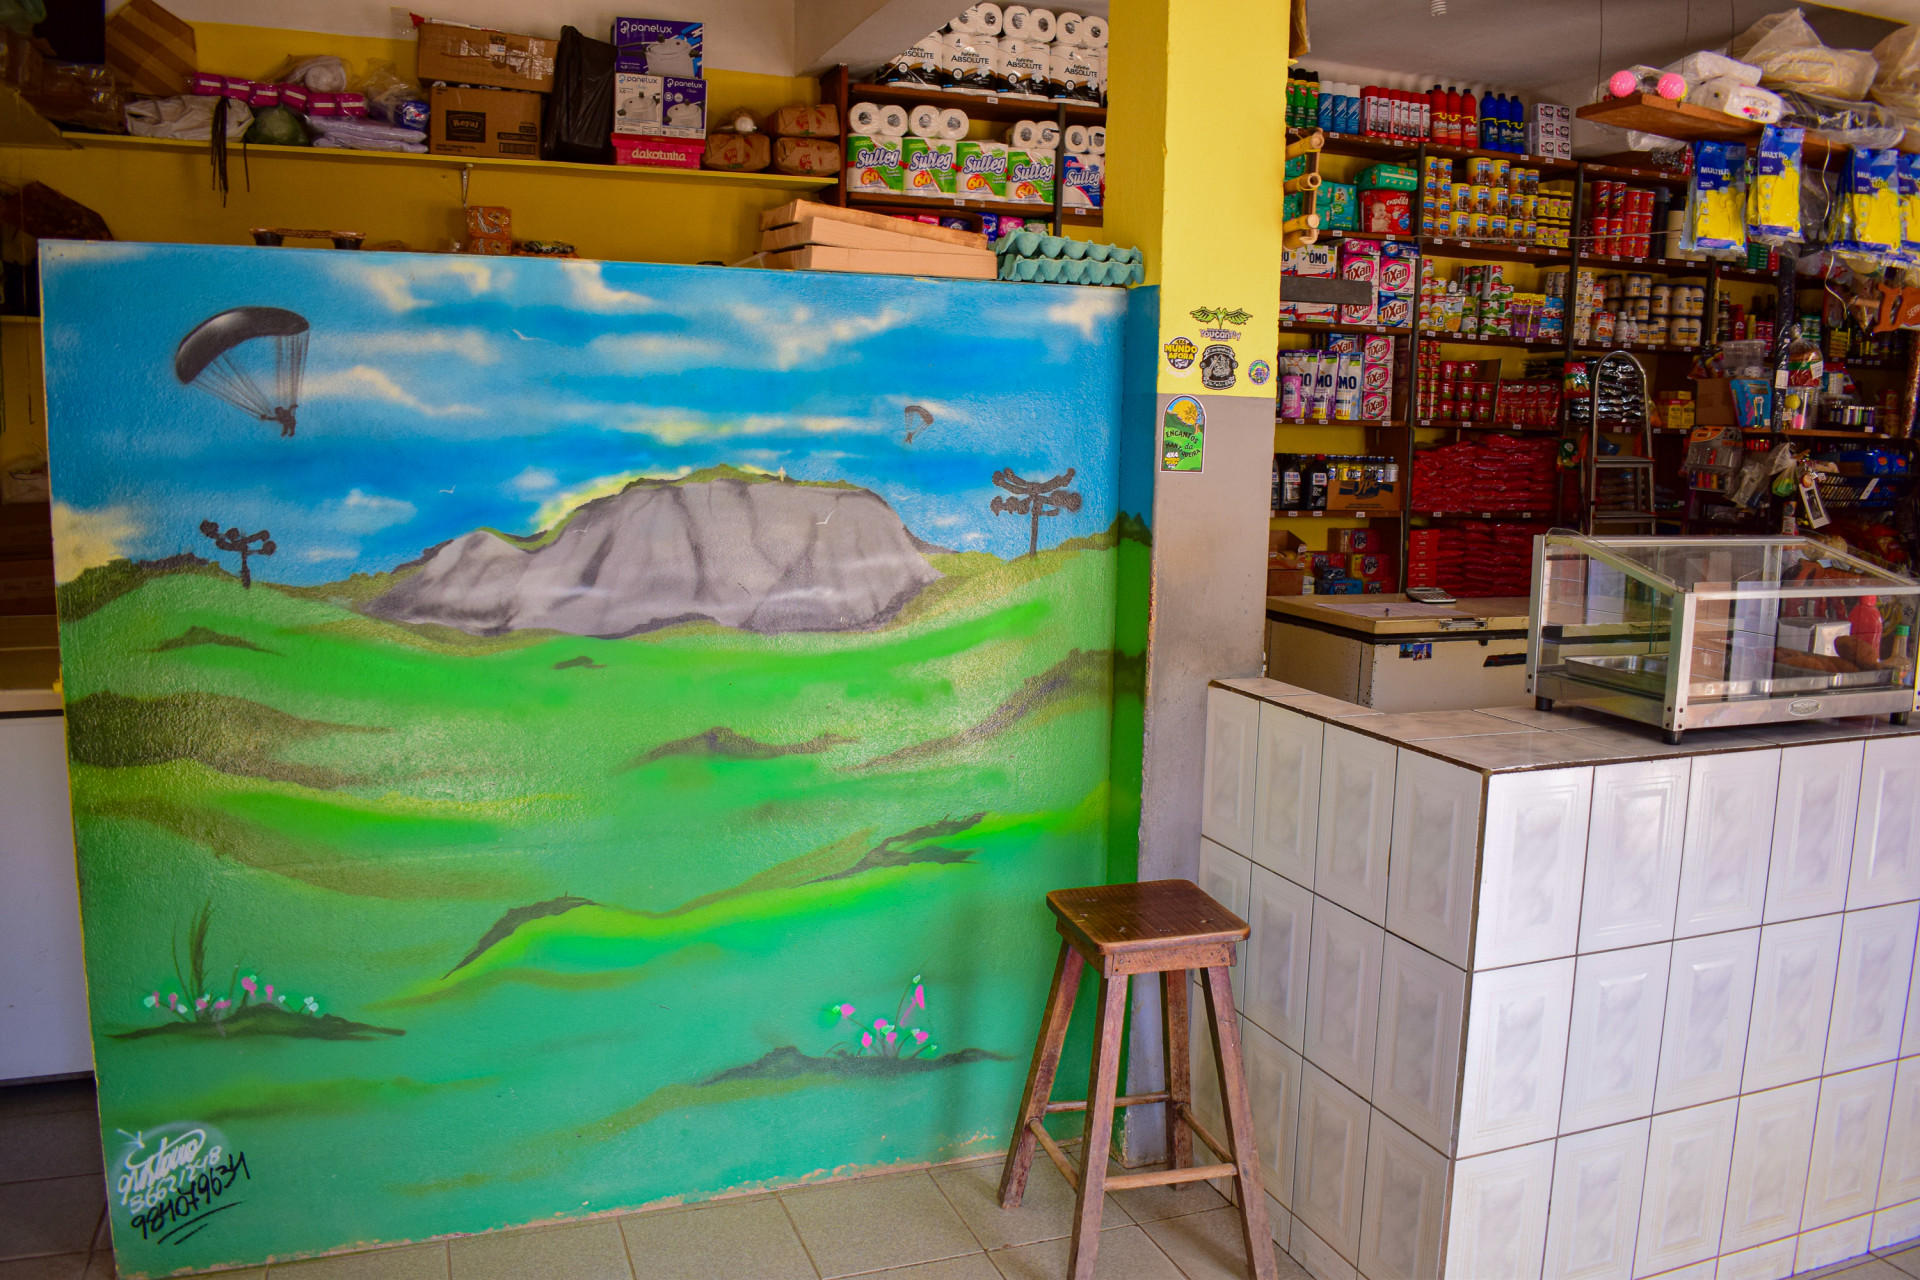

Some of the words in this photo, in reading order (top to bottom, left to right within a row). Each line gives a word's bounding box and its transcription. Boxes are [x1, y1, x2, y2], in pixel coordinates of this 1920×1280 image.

[631, 23, 673, 34] panelux
[951, 54, 989, 64] ABSOLUTE
[1006, 60, 1043, 70] ABSOLUTE
[1064, 67, 1098, 77] ABSOLUTE
[626, 76, 658, 84] panelux
[674, 80, 703, 89] panelux
[453, 119, 479, 129] Royal
[631, 147, 686, 161] dakotinha
[856, 147, 900, 169] Sulleg
[963, 155, 1006, 175] Sulleg
[861, 169, 879, 185] 60
[1012, 162, 1054, 182] Sulleg
[914, 171, 932, 187] 60
[967, 175, 986, 190] 60
[1016, 183, 1034, 198] 60
[1164, 344, 1198, 354] MUNDO
[1168, 352, 1194, 360] AFORA
[1165, 430, 1199, 445] ENCANTOS
[1184, 442, 1194, 450] da
